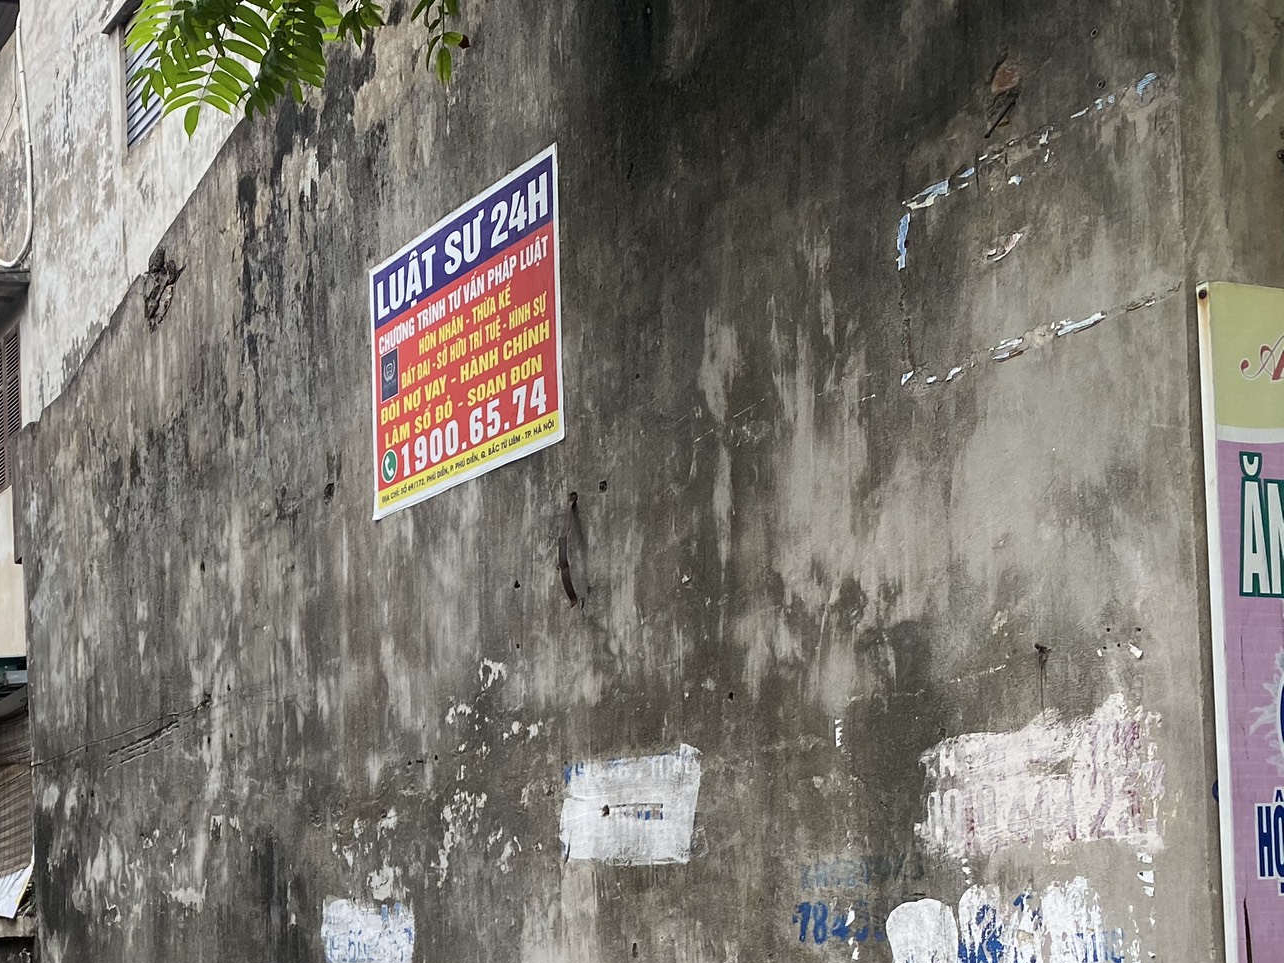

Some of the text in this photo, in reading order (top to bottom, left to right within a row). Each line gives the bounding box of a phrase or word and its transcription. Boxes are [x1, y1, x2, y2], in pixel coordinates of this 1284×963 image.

[377, 171, 548, 320] LUẬT SƯ 24H
[379, 235, 548, 355] CHƯƠNG TRÌNH TƯ VẤN PHÁP LUẬT
[418, 330, 437, 356] HÔN
[439, 314, 464, 344] NHÂN
[472, 296, 496, 324] THỪA
[498, 280, 511, 310] KẾ
[509, 302, 531, 330] HÌNH
[381, 399, 400, 426] ĐÒI
[404, 386, 421, 413] NỢ
[424, 374, 447, 401] VAY
[460, 347, 499, 384] HÀNH
[503, 319, 550, 361] CHÍNH
[384, 422, 410, 449] LÀM
[414, 403, 431, 434] SỔ
[435, 395, 453, 424] ĐỎ
[467, 372, 507, 407] SOẠN
[510, 353, 542, 386] ĐƠN
